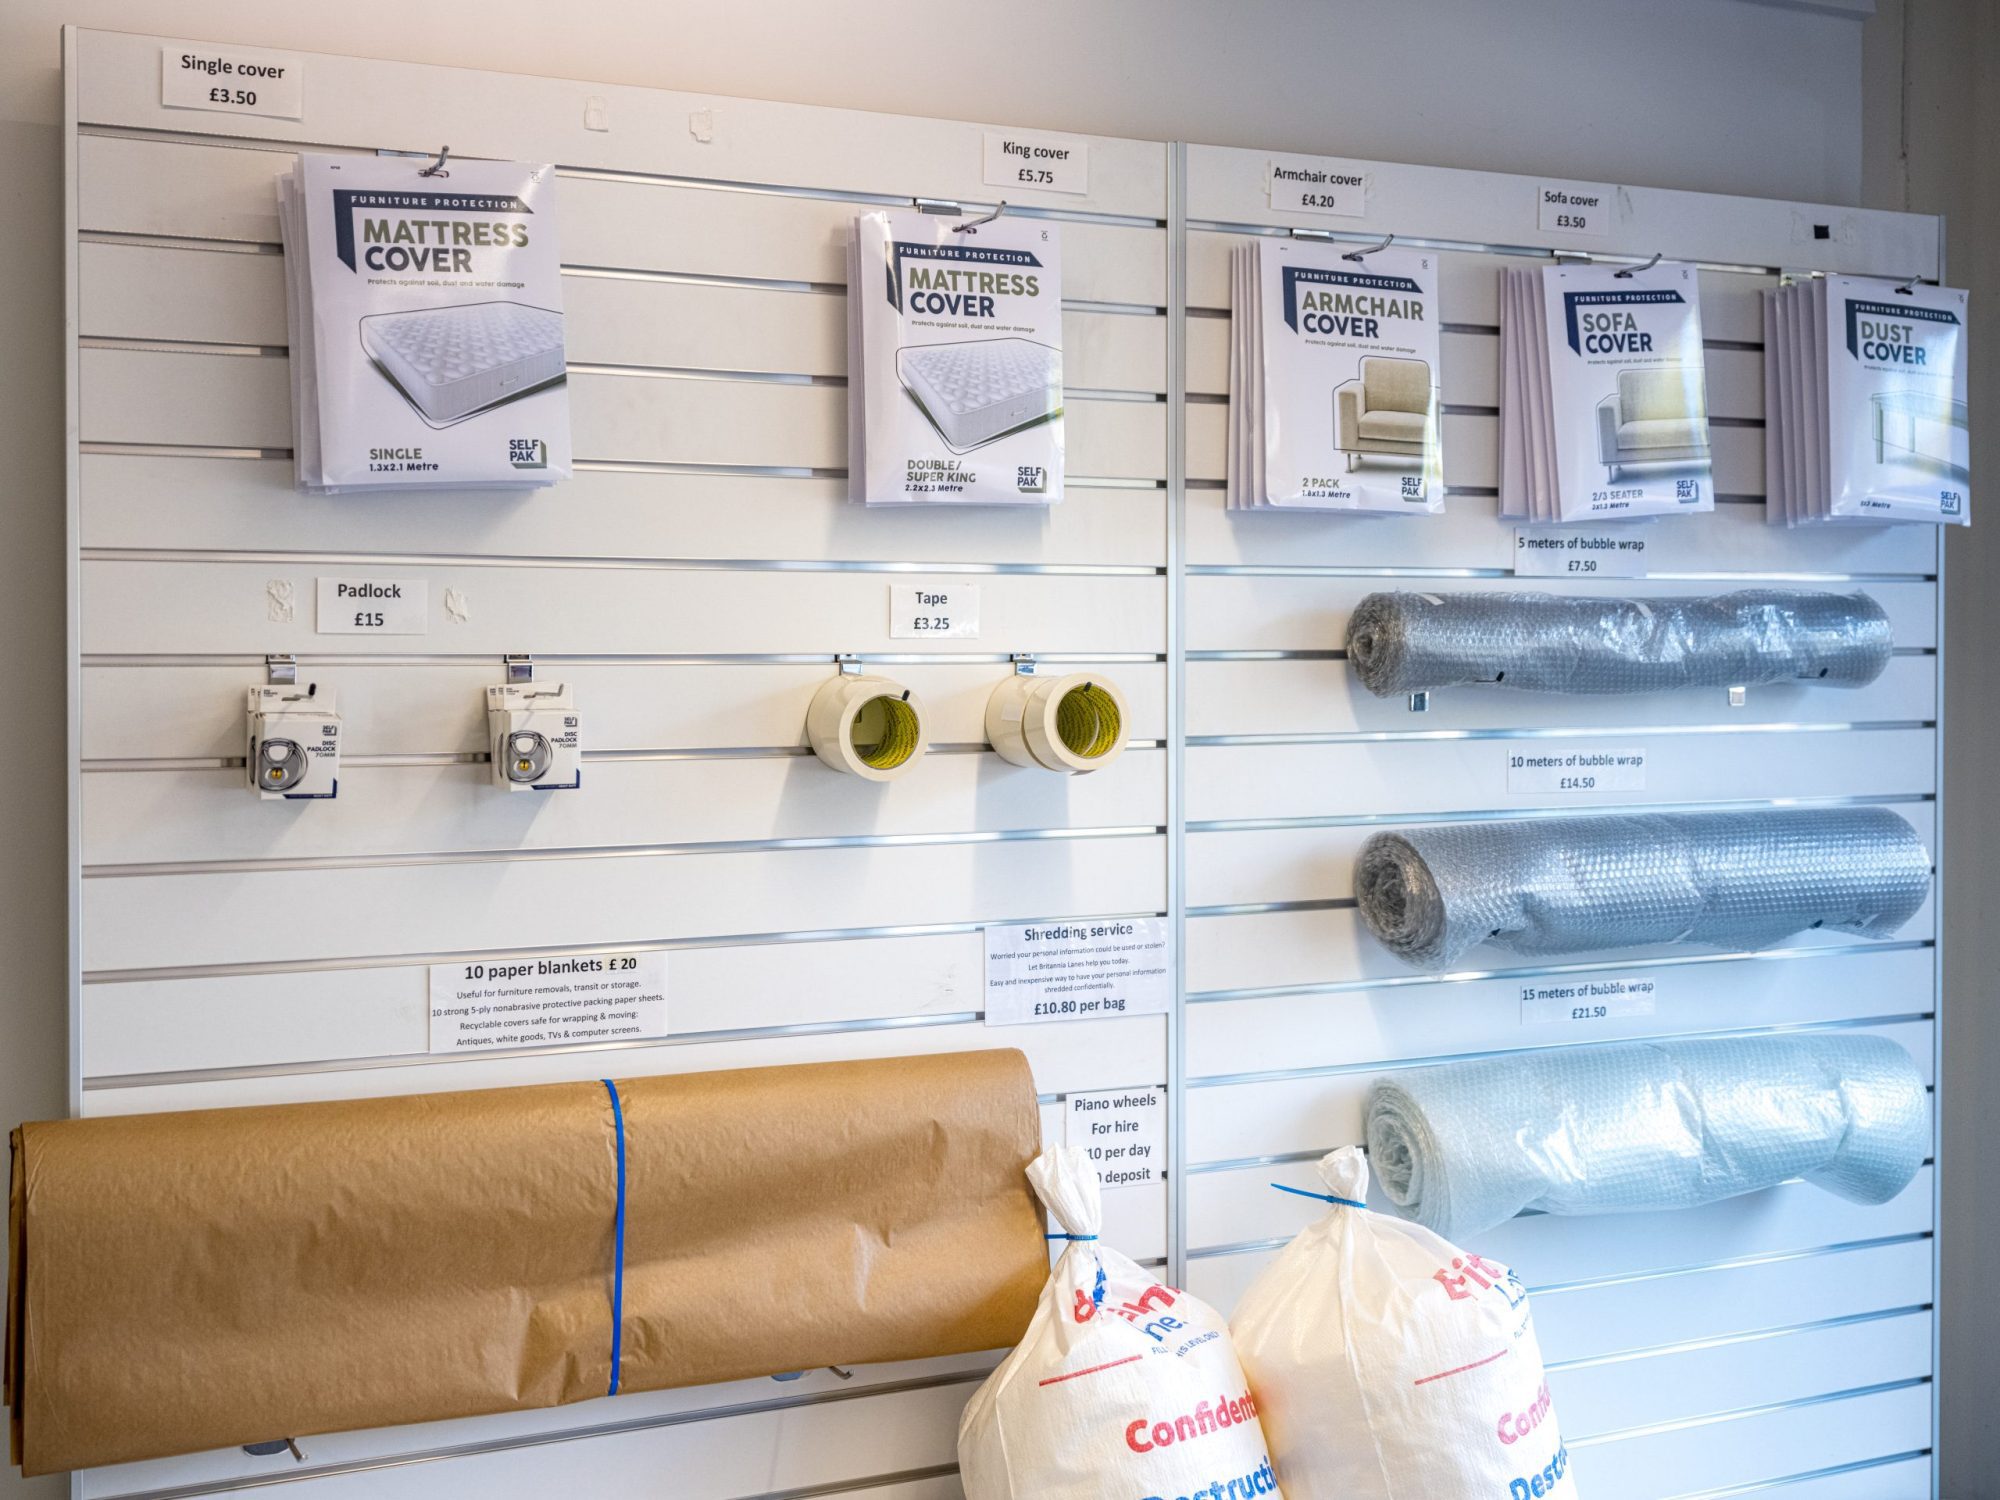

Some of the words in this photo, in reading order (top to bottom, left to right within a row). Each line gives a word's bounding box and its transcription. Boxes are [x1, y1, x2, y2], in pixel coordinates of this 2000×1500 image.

[181, 54, 232, 76] Single
[237, 64, 285, 79] cover
[209, 87, 257, 106] £3.50
[1003, 141, 1031, 159] King
[1034, 147, 1070, 160] cover
[1018, 168, 1054, 184] £5.75
[1273, 166, 1327, 184] Armchair
[1330, 175, 1363, 187] cover
[351, 195, 428, 206] FURNITURE
[435, 198, 518, 209] PROTECTION
[1301, 194, 1335, 208] £4.20
[1544, 191, 1568, 205] Sofa
[1570, 195, 1599, 208] cover
[1557, 215, 1586, 229] £3.50
[363, 218, 529, 248] MATTRESS
[365, 245, 473, 273] COVER
[899, 246, 960, 258] FURNITURE
[965, 251, 1031, 264] PROTECTION
[496, 281, 526, 289] damage
[909, 267, 1040, 297] MATTRESS
[1294, 271, 1349, 283] FURNITURE
[1353, 277, 1413, 289] PROTECTION
[910, 291, 995, 318] COVER
[1302, 290, 1424, 321] ARMCHAIR
[1574, 295, 1622, 303] FURNITURE
[1626, 294, 1677, 302] PROTECTION
[1855, 303, 1900, 315] FURNITURE
[1904, 308, 1953, 321] PROTECTION
[1303, 313, 1379, 339] COVER
[1583, 312, 1638, 333] SOFA
[1861, 320, 1913, 344] DUST
[1585, 332, 1653, 354] COVER
[1863, 341, 1926, 366] COVER
[509, 439, 539, 451] SELF
[369, 448, 422, 461] SINGLE
[510, 451, 535, 462] PAK
[369, 463, 403, 472] 1.3x2.1
[406, 462, 439, 472] Metre
[907, 459, 962, 471] DOUBLE/
[1017, 466, 1042, 476] SELF
[907, 472, 944, 482] SUPER
[948, 472, 976, 483] KING
[1017, 476, 1037, 487] PAK
[1303, 478, 1309, 488] 2
[1312, 478, 1340, 488] PACK
[1402, 477, 1422, 487] SELF
[1676, 480, 1695, 490] SELF
[938, 484, 963, 493] Metre
[1328, 491, 1351, 499] Metre
[1402, 487, 1419, 496] PAK
[1592, 491, 1608, 501] 2/3
[1610, 489, 1643, 500] SEATER
[1677, 489, 1692, 498] PAK
[1941, 491, 1957, 500] SELF
[1941, 500, 1955, 509] PAK
[1519, 537, 1525, 548] 5
[1527, 539, 1565, 549] meters
[1567, 537, 1578, 549] of
[1580, 538, 1616, 550] bubble
[1619, 540, 1645, 552] wrap
[1568, 560, 1597, 572] £7.50
[338, 583, 401, 598] Padlock
[915, 591, 948, 607] Tape
[354, 612, 384, 627] £15
[913, 617, 950, 630] £3.25
[1511, 756, 1524, 768] 10
[1526, 757, 1563, 767] meters
[1565, 755, 1576, 766] of
[1579, 754, 1614, 766] bubble
[1617, 756, 1643, 767] wrap
[1560, 777, 1595, 789] £14.50
[1024, 926, 1087, 941] Shredding
[1090, 923, 1133, 937] service
[990, 951, 1016, 960] Worried
[1032, 949, 1058, 959] personal
[1060, 947, 1094, 955] information
[1096, 945, 1111, 953] could
[1121, 943, 1136, 951] used
[465, 965, 484, 980] 10
[489, 965, 533, 981] paper
[538, 959, 603, 975] blankets
[609, 959, 617, 971] £
[621, 957, 637, 970] 20
[1085, 960, 1098, 968] help
[1018, 976, 1053, 985] inexpensive
[1106, 970, 1131, 979] personal
[1132, 968, 1166, 976] information
[456, 990, 482, 1000] Useful
[484, 989, 496, 998] for
[497, 987, 533, 997] furniture
[534, 984, 572, 994] removals,
[574, 983, 599, 992] transit
[611, 981, 642, 990] storage.
[1044, 985, 1073, 994] shredded
[1522, 989, 1535, 1001] 15
[1538, 988, 1575, 1000] meters
[1577, 984, 1589, 997] of
[1590, 982, 1626, 996] bubble
[1628, 982, 1654, 994] wrap
[432, 1009, 442, 1017] 10
[443, 1007, 469, 1016] strong
[471, 1005, 491, 1015] 5-ply
[493, 1002, 541, 1012] nonabrasive
[542, 999, 582, 1010] protective
[583, 997, 613, 1007] packing
[614, 996, 637, 1005] paper
[638, 993, 665, 1002] sheets.
[1034, 1000, 1076, 1015] £10.80
[1080, 1000, 1100, 1014] per
[1103, 997, 1126, 1011] bag
[1572, 1006, 1607, 1019] £21.50
[460, 1020, 502, 1031] Recyclable
[503, 1018, 529, 1027] covers
[531, 1017, 547, 1025] safe
[549, 1016, 560, 1024] for
[562, 1013, 598, 1023] wrapping
[600, 1012, 606, 1020] &
[456, 1037, 494, 1046] Antiques,
[496, 1034, 519, 1043] white
[520, 1032, 546, 1043] goods,
[548, 1031, 562, 1039] TVs
[563, 1030, 570, 1038] &
[572, 1028, 610, 1038] computer
[611, 1025, 642, 1035] screens.
[1075, 1098, 1110, 1111] Piano
[1113, 1093, 1157, 1108] wheels
[1092, 1122, 1112, 1135] For
[1115, 1120, 1139, 1133] hire
[1085, 1147, 1102, 1160] 10
[1105, 1147, 1126, 1160] per
[1129, 1144, 1151, 1158] day
[1105, 1168, 1151, 1184] deposit
